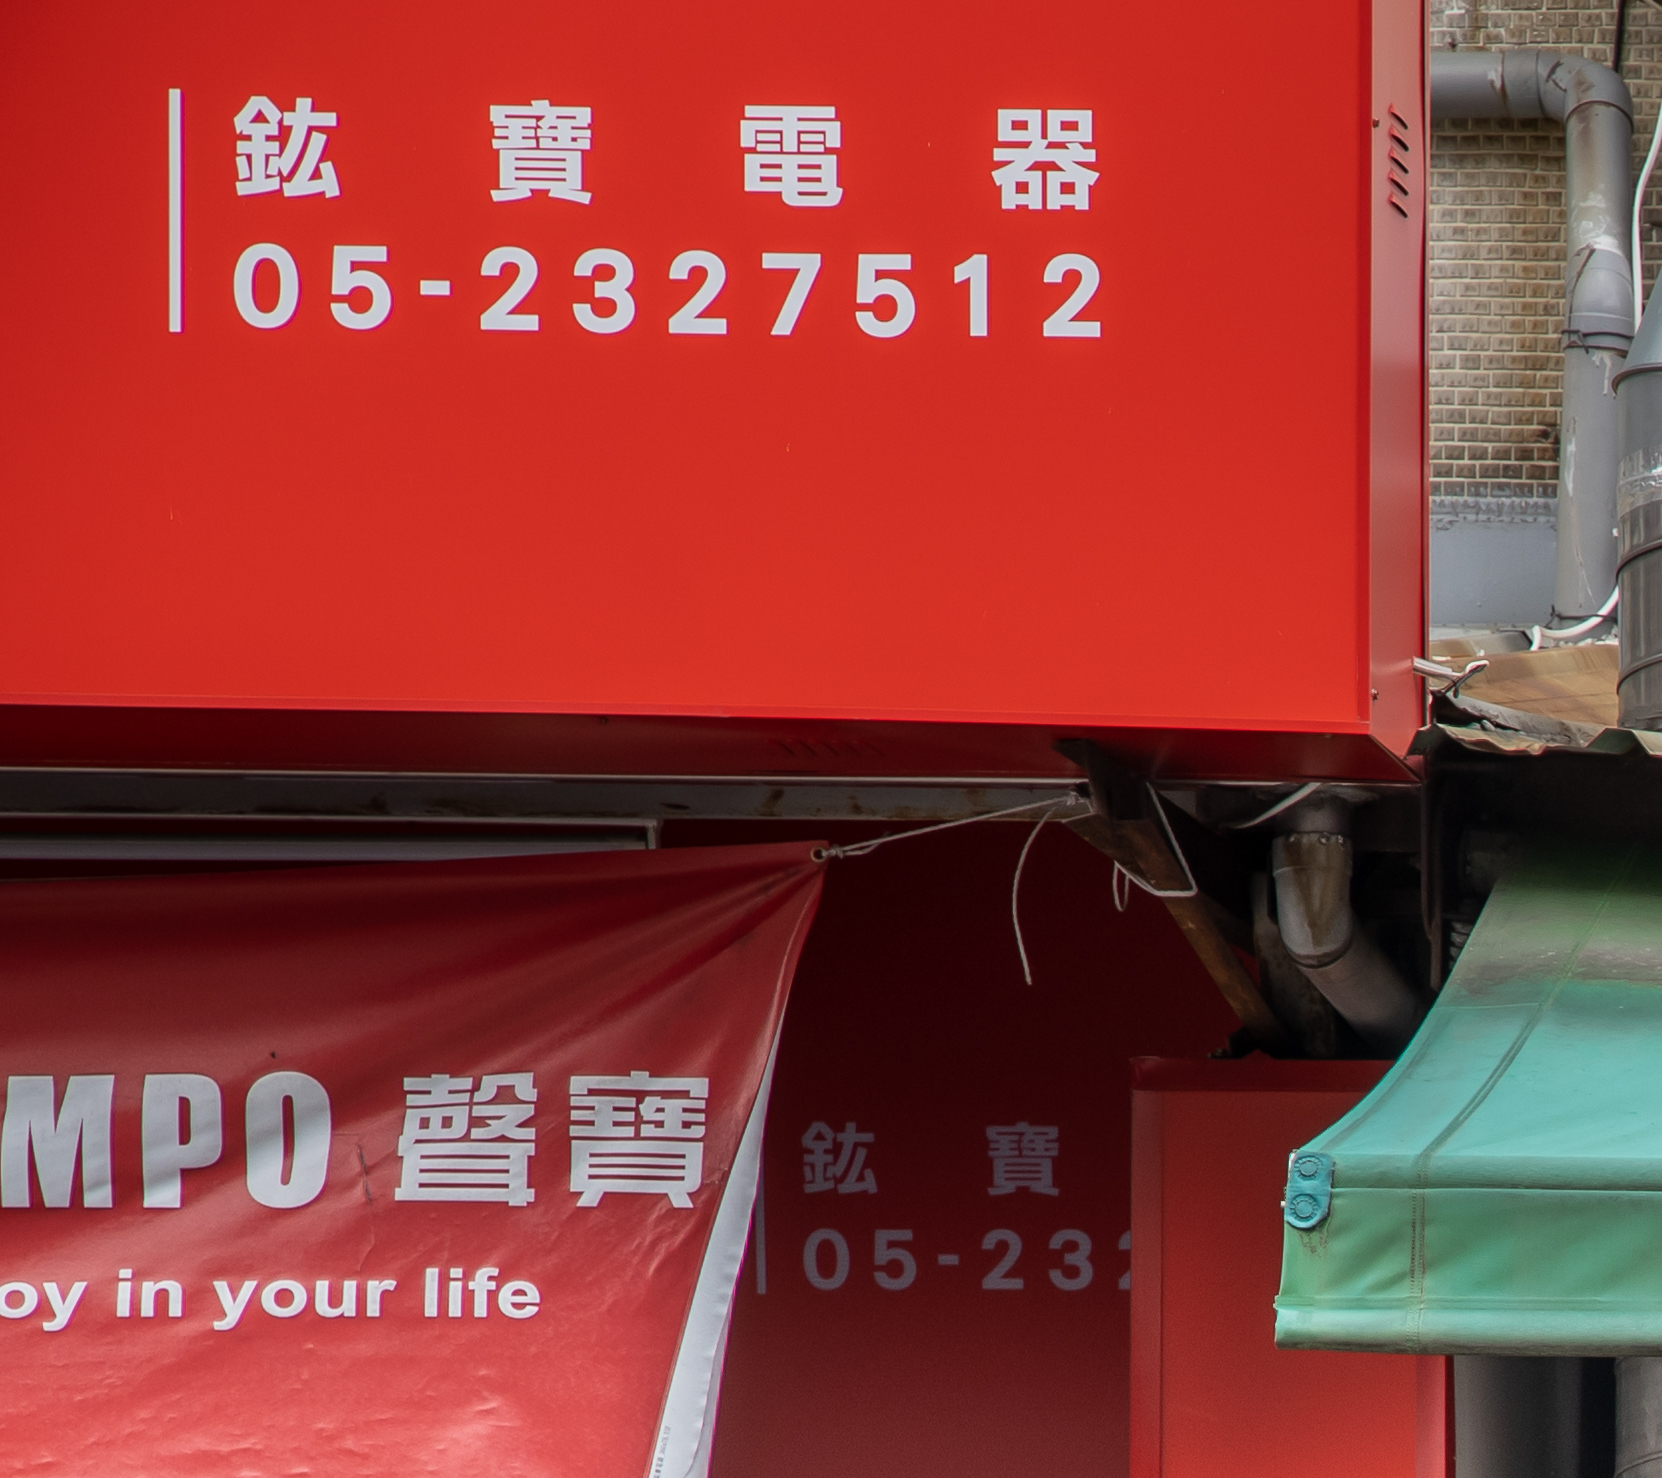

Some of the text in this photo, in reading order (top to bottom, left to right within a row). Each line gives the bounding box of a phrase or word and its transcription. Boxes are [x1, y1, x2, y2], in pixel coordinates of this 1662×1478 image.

[233, 97, 1100, 210] 鉉寶電器
[233, 243, 1103, 338] 05-2327512
[396, 1072, 709, 1208] 聲寶
[117, 1268, 183, 1318] in
[212, 1272, 396, 1330] your
[423, 1266, 541, 1319] life
